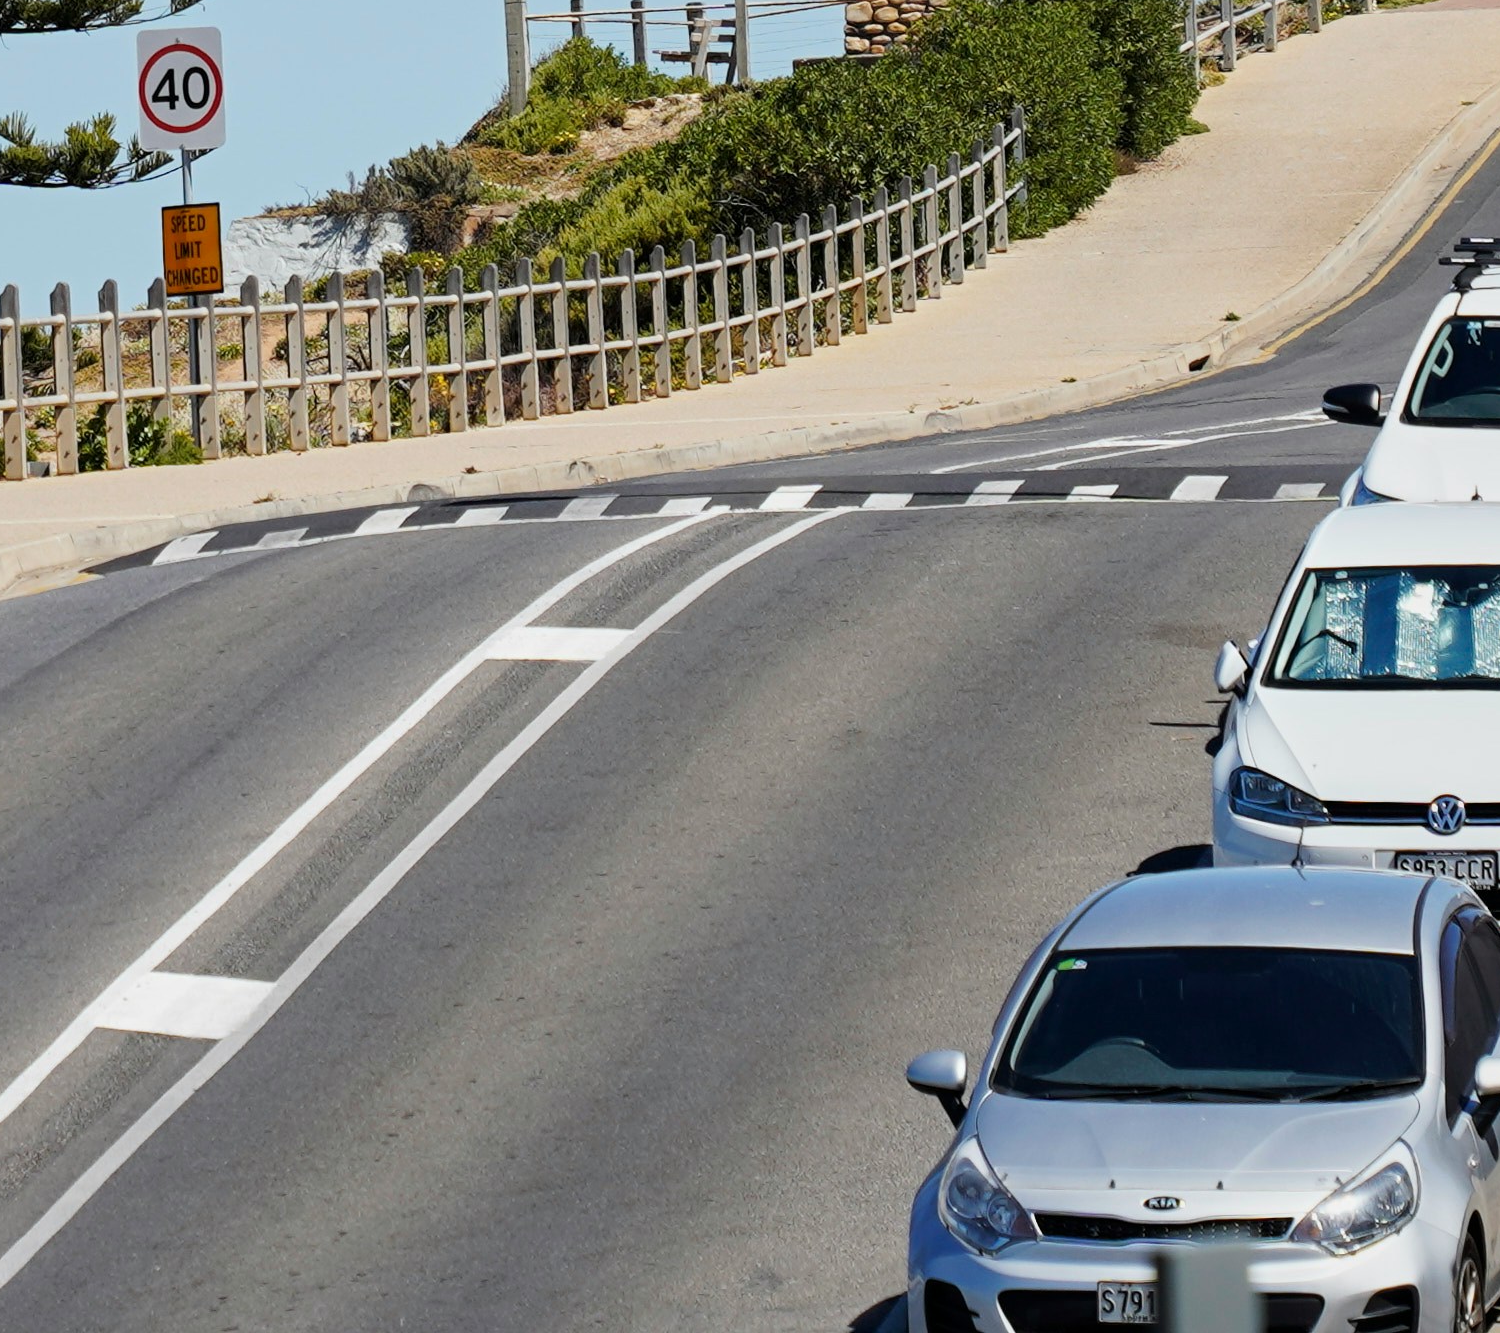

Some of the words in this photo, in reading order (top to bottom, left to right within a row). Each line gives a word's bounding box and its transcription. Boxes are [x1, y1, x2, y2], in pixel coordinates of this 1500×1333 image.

[151, 66, 211, 111] 40
[171, 214, 206, 234] SPEED
[174, 240, 202, 260] LIMIT
[166, 266, 219, 287] CHANGED
[1147, 1197, 1179, 1209] KIA
